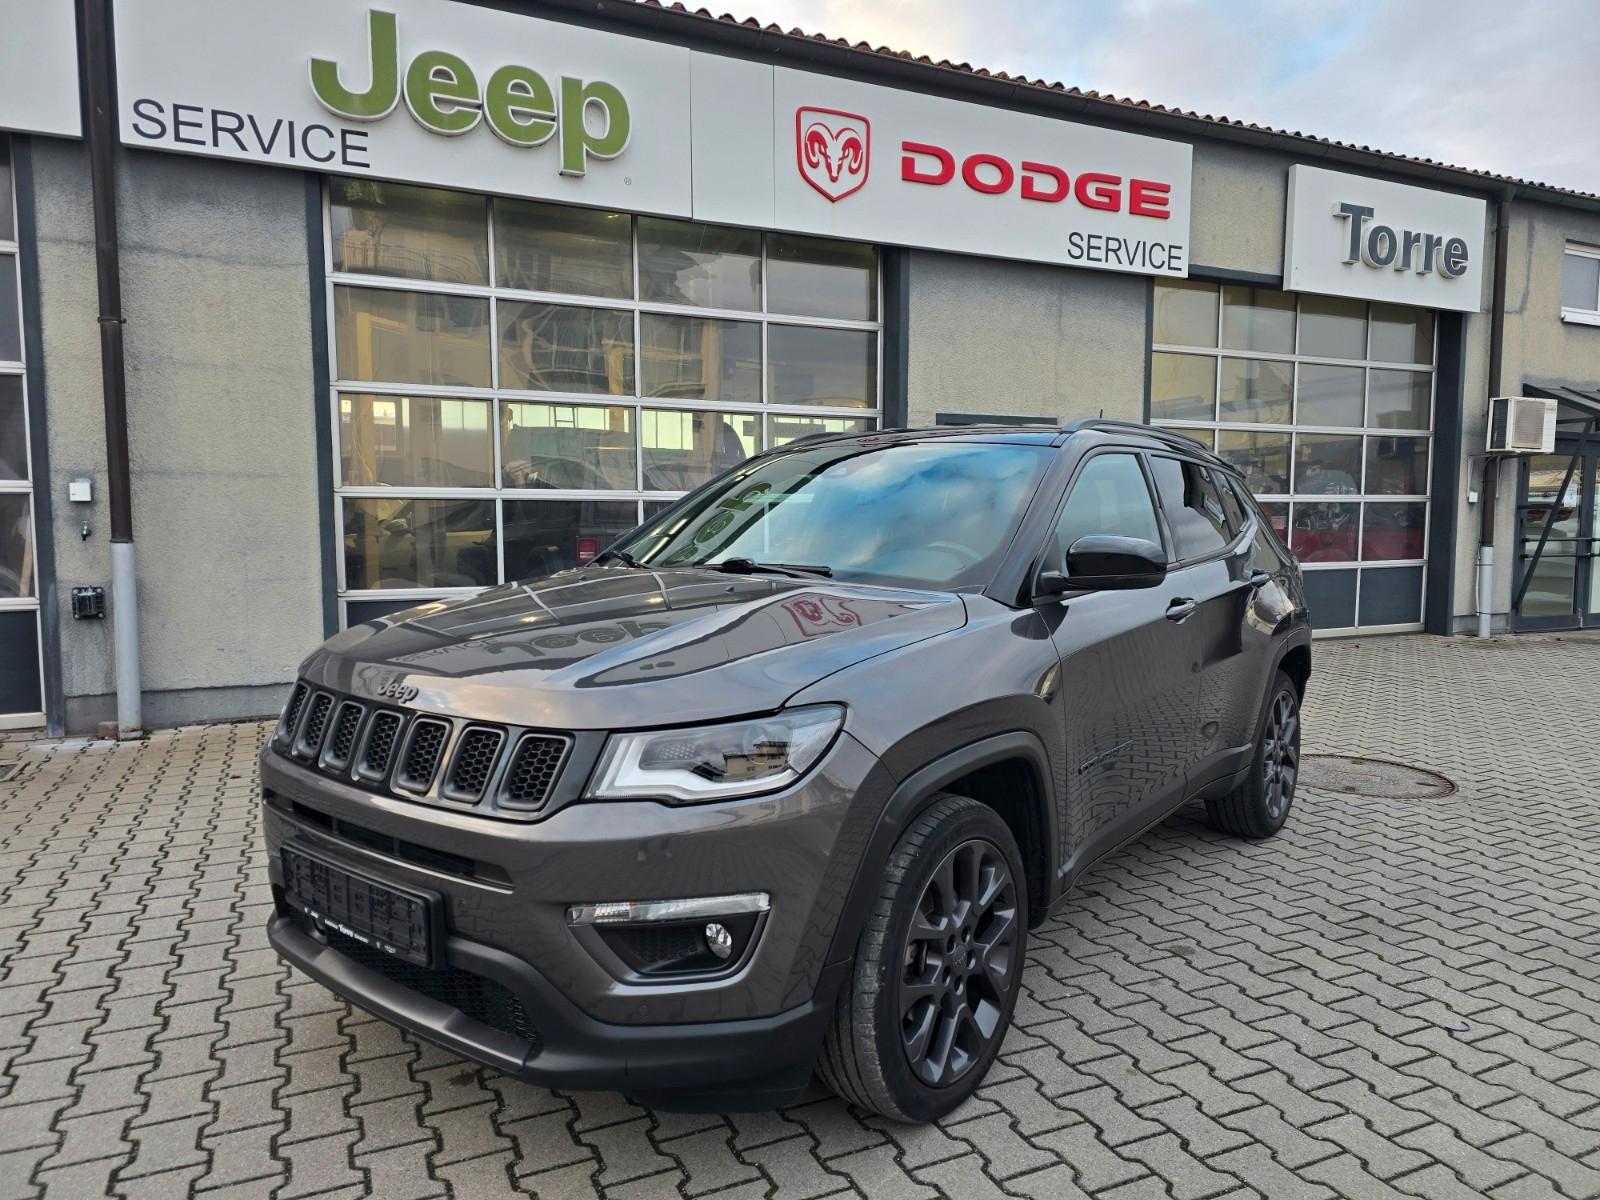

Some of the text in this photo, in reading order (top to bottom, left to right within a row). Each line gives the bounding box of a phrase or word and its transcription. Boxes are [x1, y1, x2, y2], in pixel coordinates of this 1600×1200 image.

[309, 8, 632, 178] Jeep
[132, 98, 371, 169] SERVICE
[901, 141, 1172, 220] DODGE
[1067, 231, 1183, 272] SERVICE
[1333, 201, 1469, 279] Torre
[376, 679, 419, 704] Jeep
